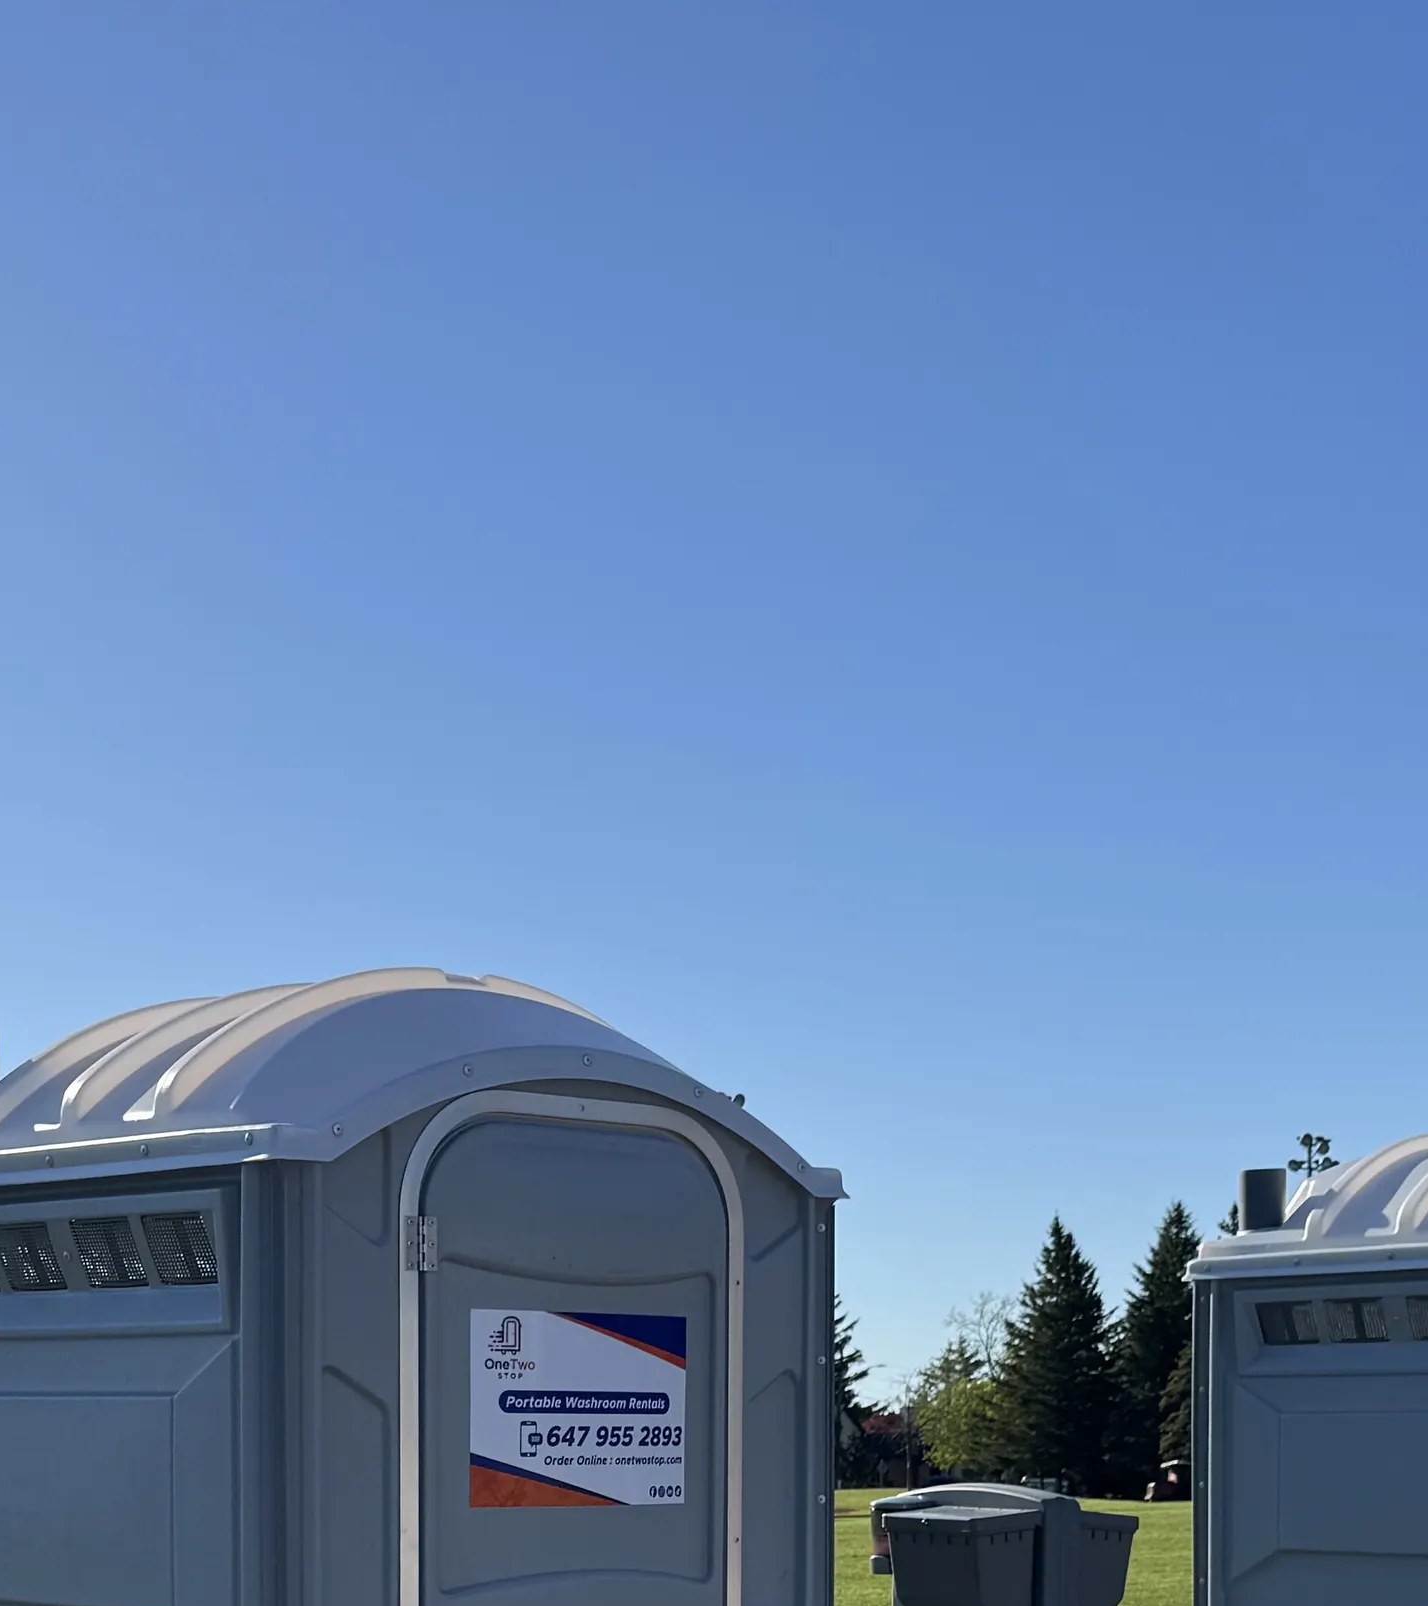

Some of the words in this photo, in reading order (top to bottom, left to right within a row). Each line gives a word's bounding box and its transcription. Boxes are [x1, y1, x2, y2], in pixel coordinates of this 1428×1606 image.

[484, 1358, 535, 1370] OneTwo
[506, 1396, 562, 1409] Portable
[565, 1397, 627, 1409] Washroom
[628, 1398, 665, 1410] Rentals
[546, 1425, 590, 1447] 647
[595, 1425, 634, 1447] 955
[638, 1425, 682, 1447] 2893
[544, 1455, 574, 1466] Order
[576, 1454, 608, 1466] Online
[615, 1455, 682, 1467] onetwostop.com
